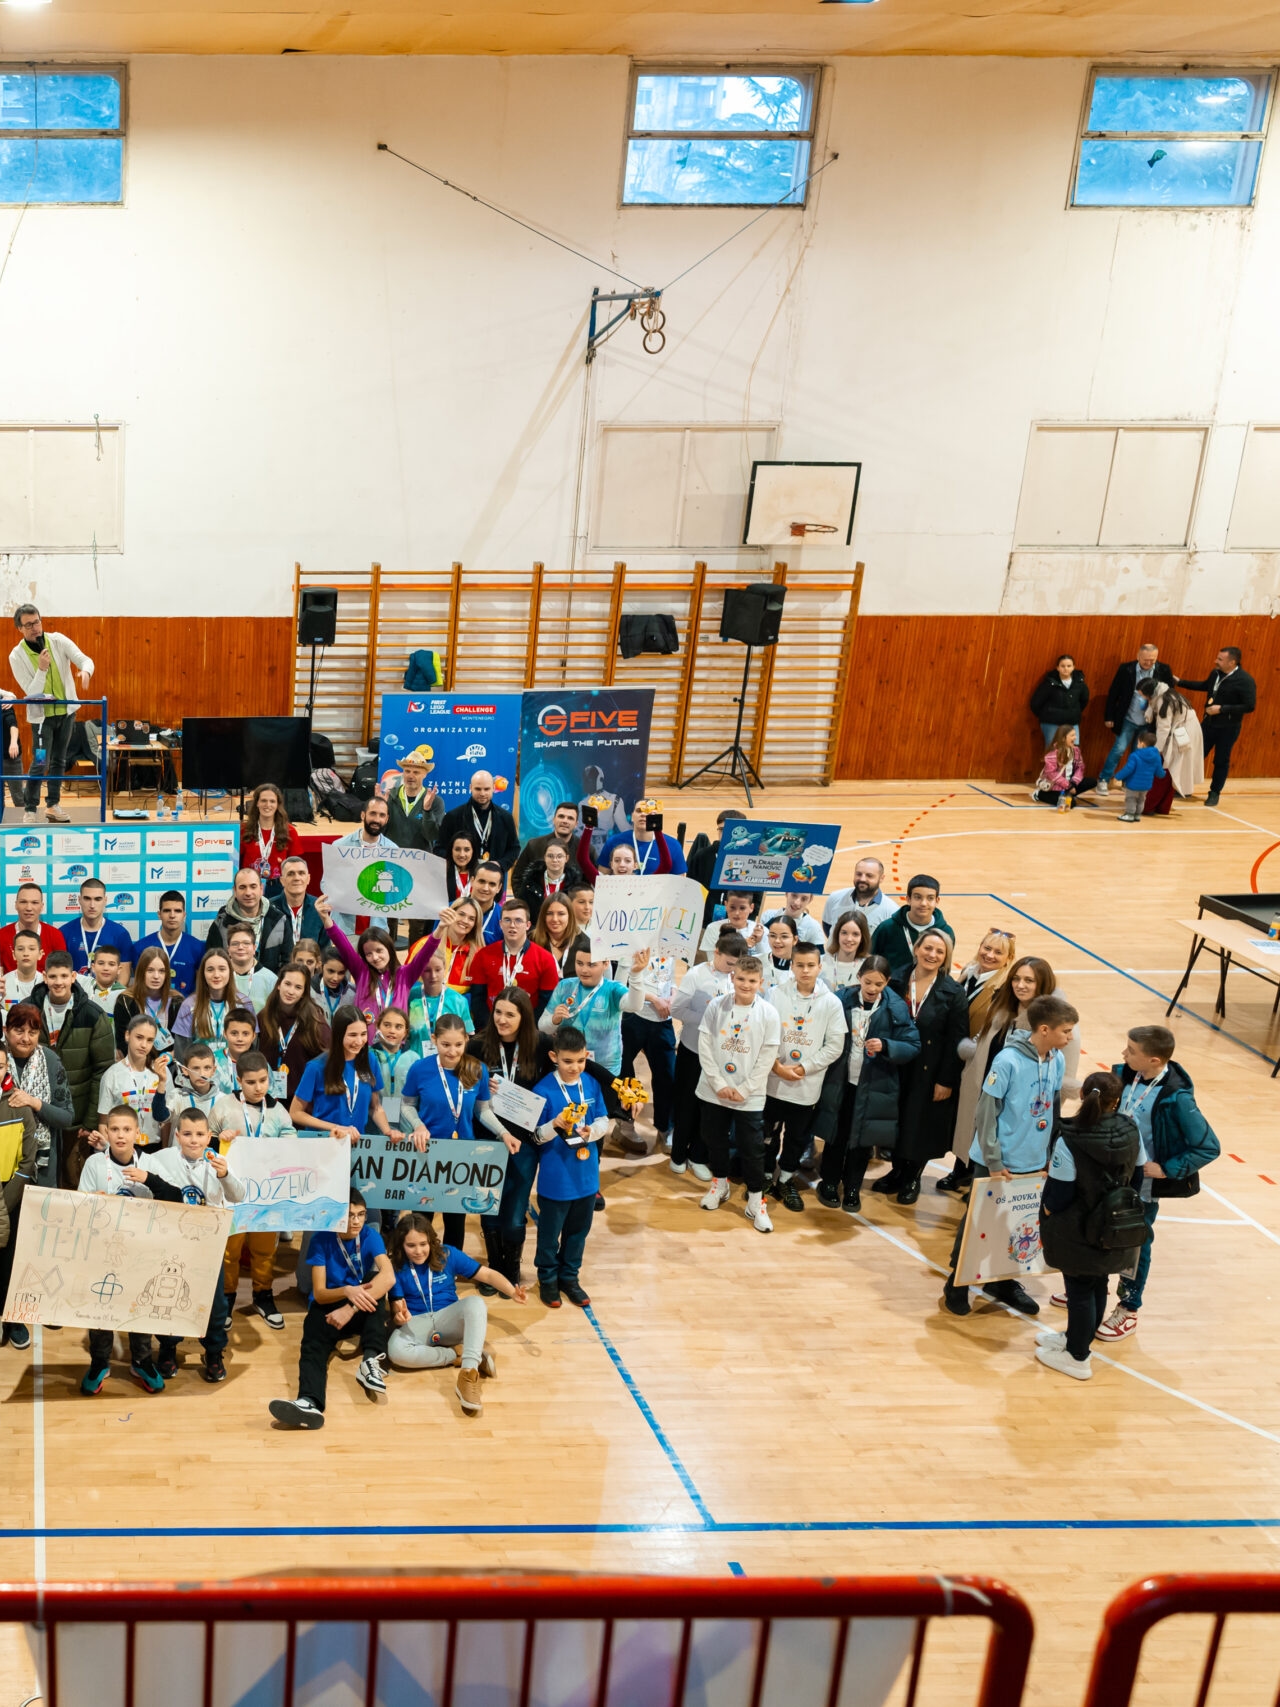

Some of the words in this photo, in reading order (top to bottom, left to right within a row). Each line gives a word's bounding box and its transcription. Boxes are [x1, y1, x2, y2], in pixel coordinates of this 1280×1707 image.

[534, 740, 569, 748] SHAPE
[597, 738, 640, 746] FUTURE
[338, 847, 427, 860] VODOZEMCI
[350, 1156, 384, 1180] AN
[392, 1158, 504, 1188] DIAMOND
[384, 1188, 406, 1201] BAR
